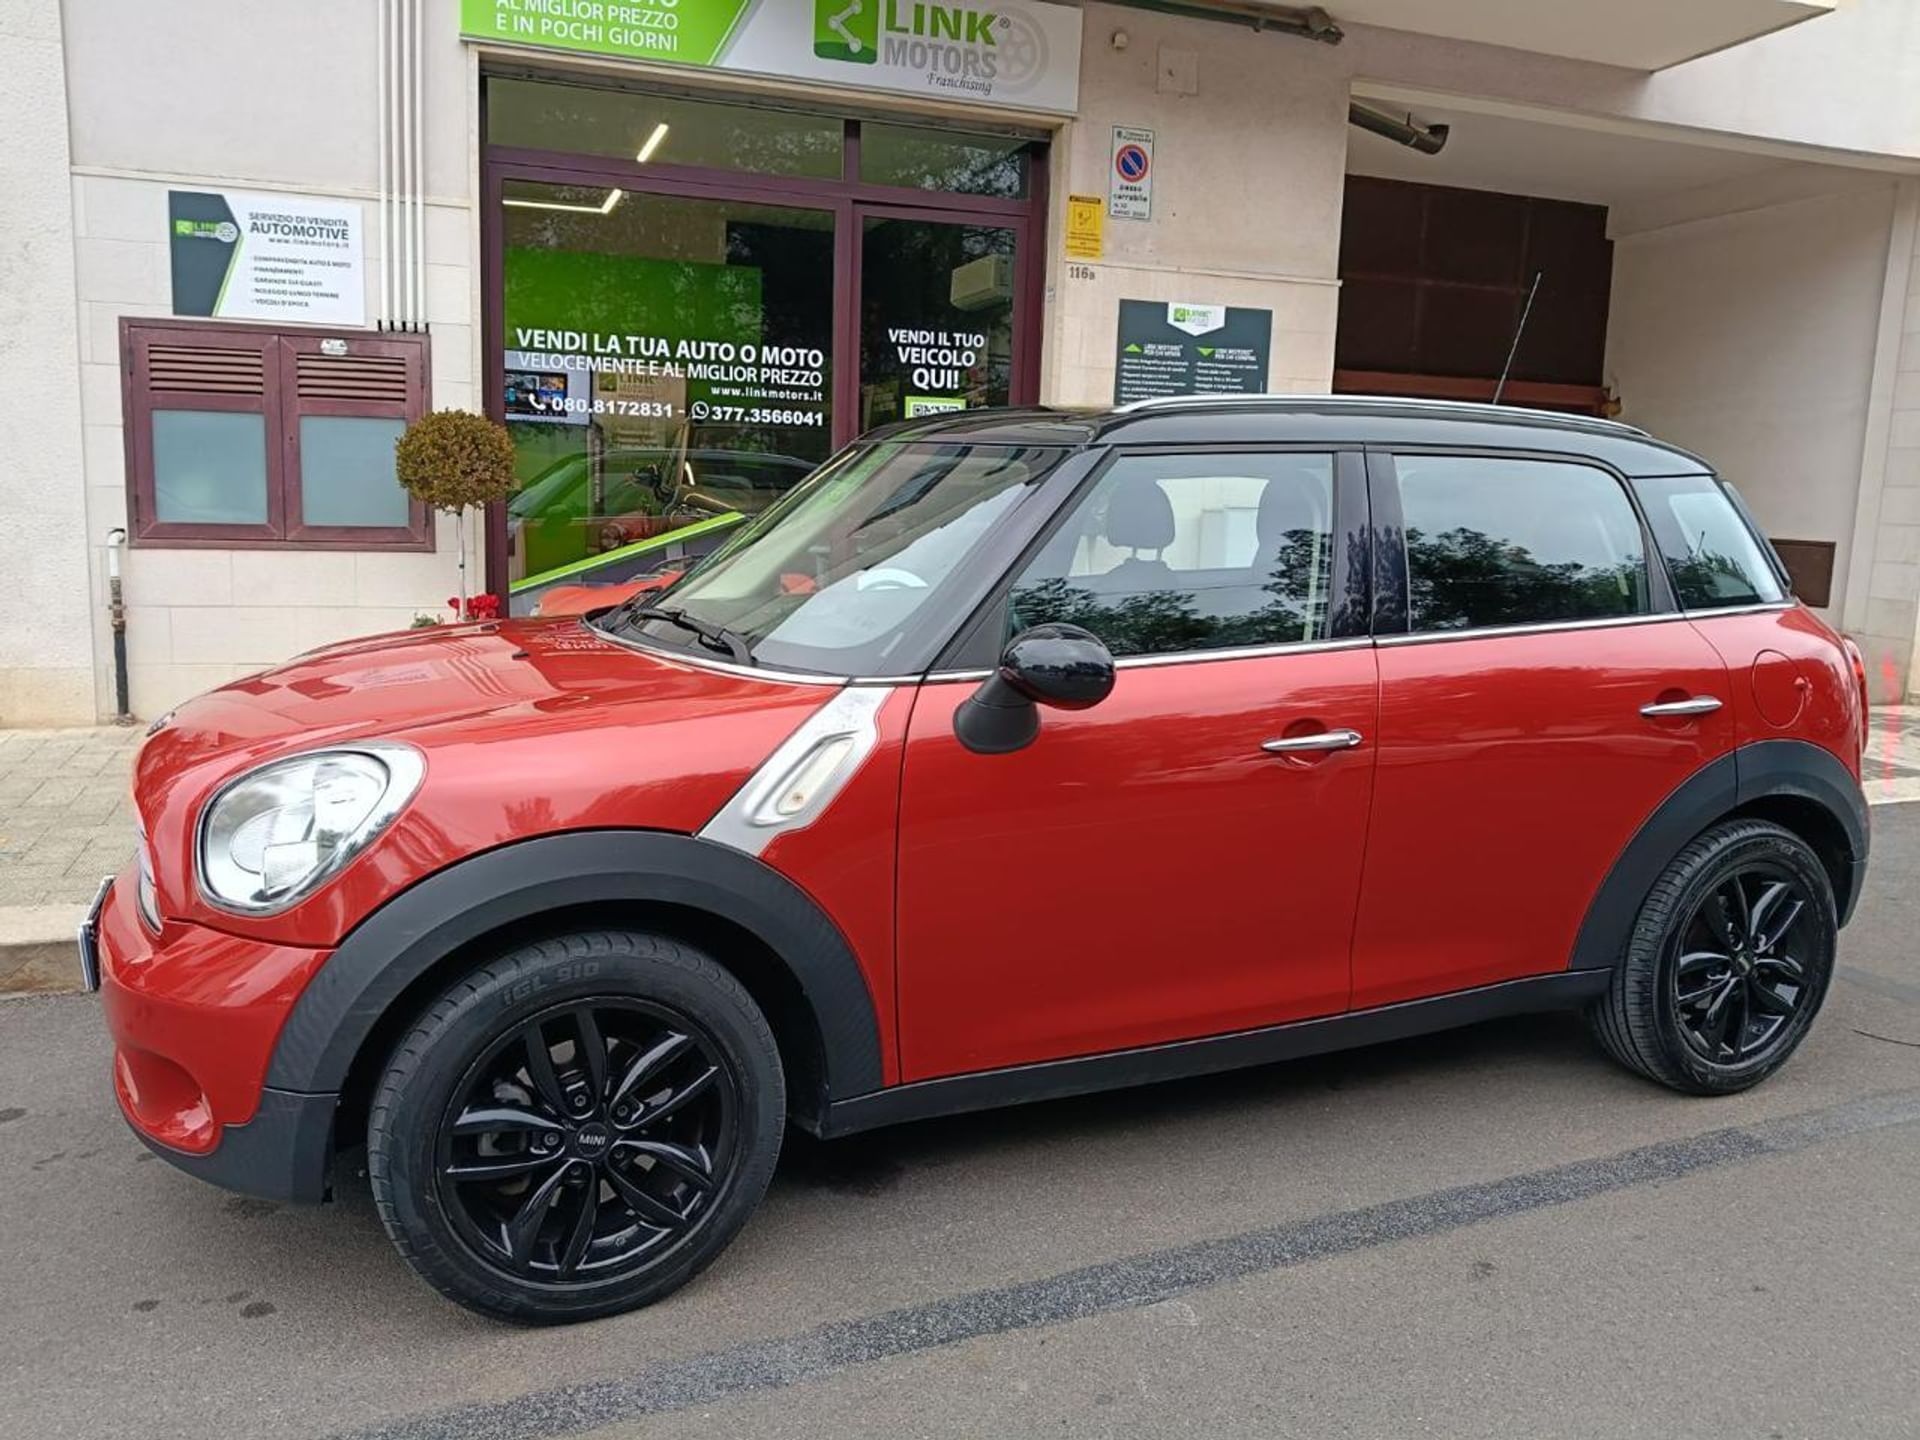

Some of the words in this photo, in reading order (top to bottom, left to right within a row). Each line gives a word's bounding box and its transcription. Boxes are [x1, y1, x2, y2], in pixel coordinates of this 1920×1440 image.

[524, 0, 603, 20] MIGLIOR
[608, 6, 678, 30] PREZZO
[496, 14, 507, 30] E
[514, 15, 533, 34] IN
[541, 19, 603, 42] POCHI
[609, 27, 677, 52] GIORNI
[884, 37, 998, 80] MOTORS
[926, 72, 992, 96] Franchising
[248, 212, 294, 224] SERVIZIO
[295, 215, 306, 224] DI
[307, 216, 349, 227] VENDITA
[250, 221, 349, 240] AUTOMOTIVE
[516, 328, 587, 351] VENDI
[593, 334, 621, 354] LA
[625, 336, 670, 358] TUA
[675, 340, 736, 362] AUTO
[740, 344, 757, 364] O
[761, 346, 824, 368] MOTO
[888, 328, 934, 345] VENDI
[938, 332, 951, 346] IL
[953, 332, 985, 348] TUO
[898, 346, 976, 367] VEICOLO
[517, 351, 645, 375] VELOCEMENTE
[648, 360, 658, 376] E
[662, 362, 685, 378] AL
[687, 363, 757, 382] MIGLIOR
[760, 368, 823, 387] PREZZO
[912, 367, 960, 391] QUI!
[711, 386, 823, 402] www.linkmotors.it
[552, 397, 672, 418] 080.8172831
[711, 406, 824, 426] 377.3566041
[579, 1133, 606, 1146] MINI
